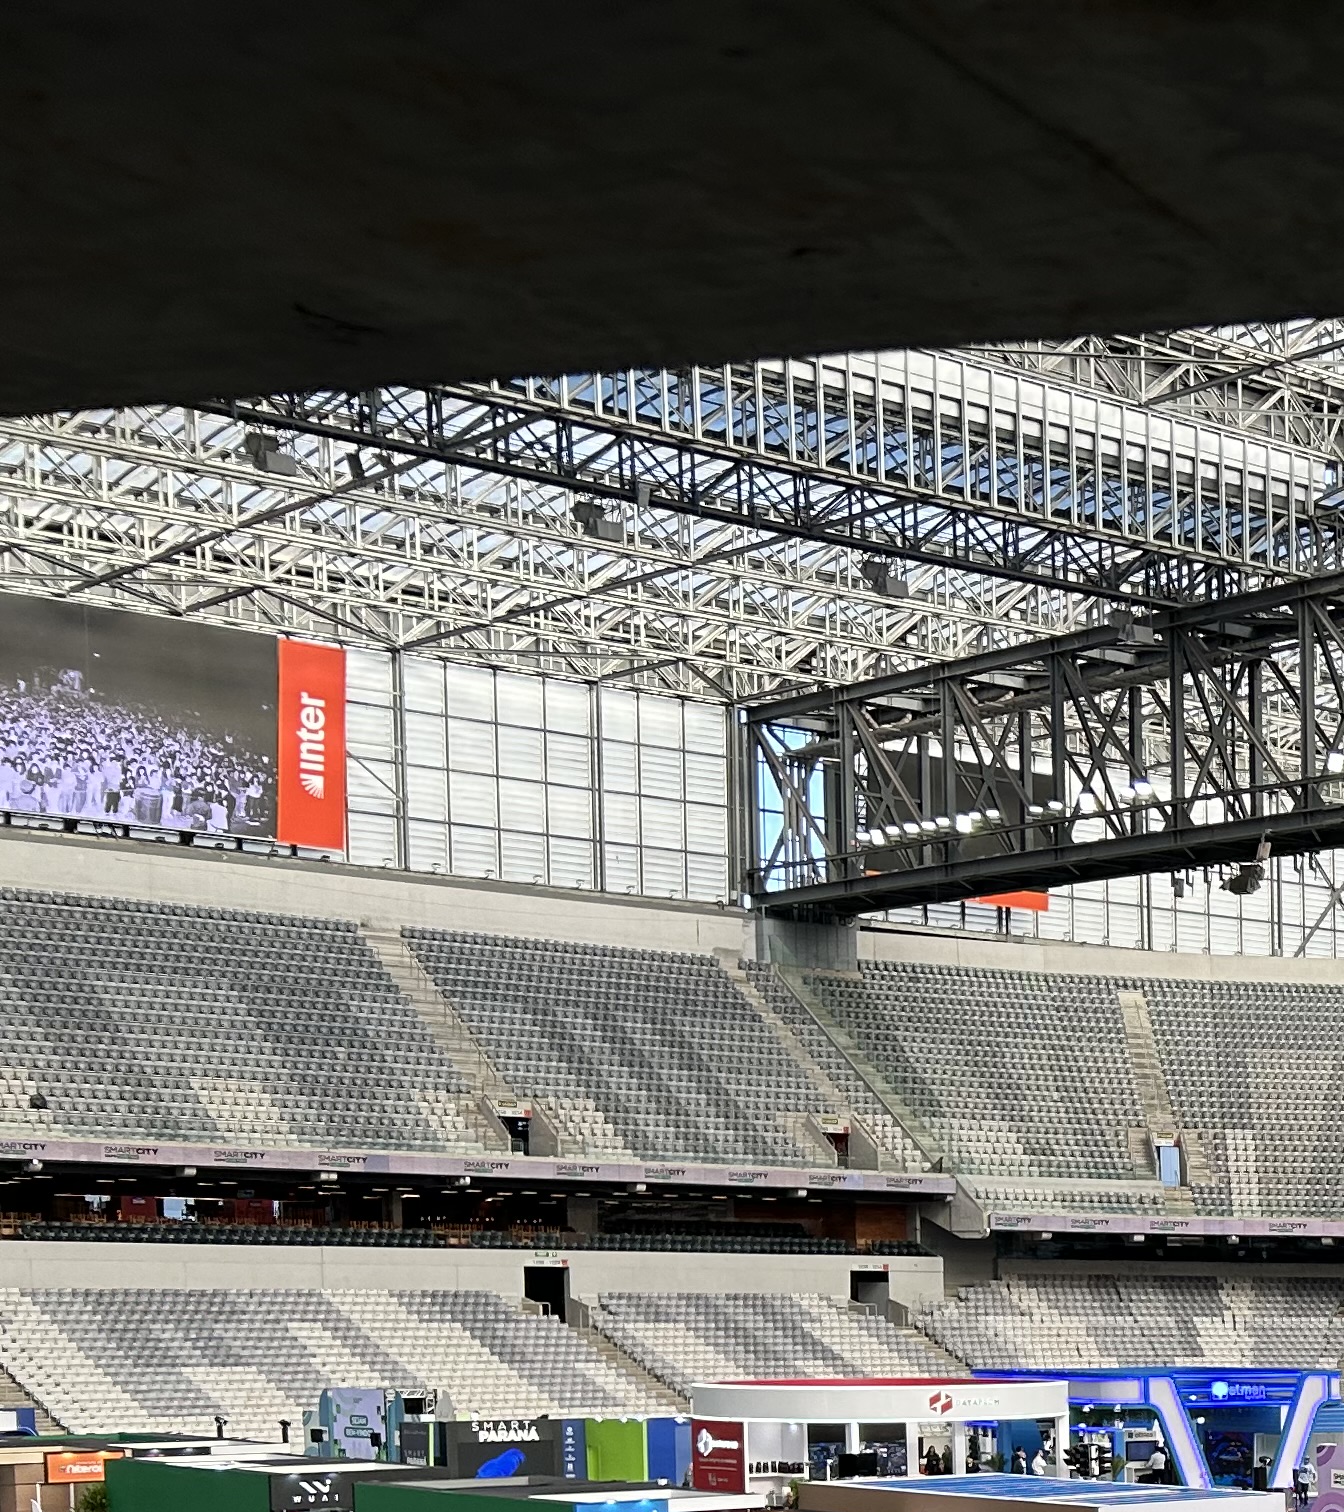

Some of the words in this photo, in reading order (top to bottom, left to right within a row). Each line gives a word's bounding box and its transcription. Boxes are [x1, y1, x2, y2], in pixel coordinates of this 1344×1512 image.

[104, 1146, 159, 1157] SMARTCITY
[214, 1150, 265, 1160] SMARTCITY
[318, 1154, 367, 1164] SMARTCITY
[472, 1420, 530, 1432] SMART
[479, 1426, 539, 1442] PARANÁ
